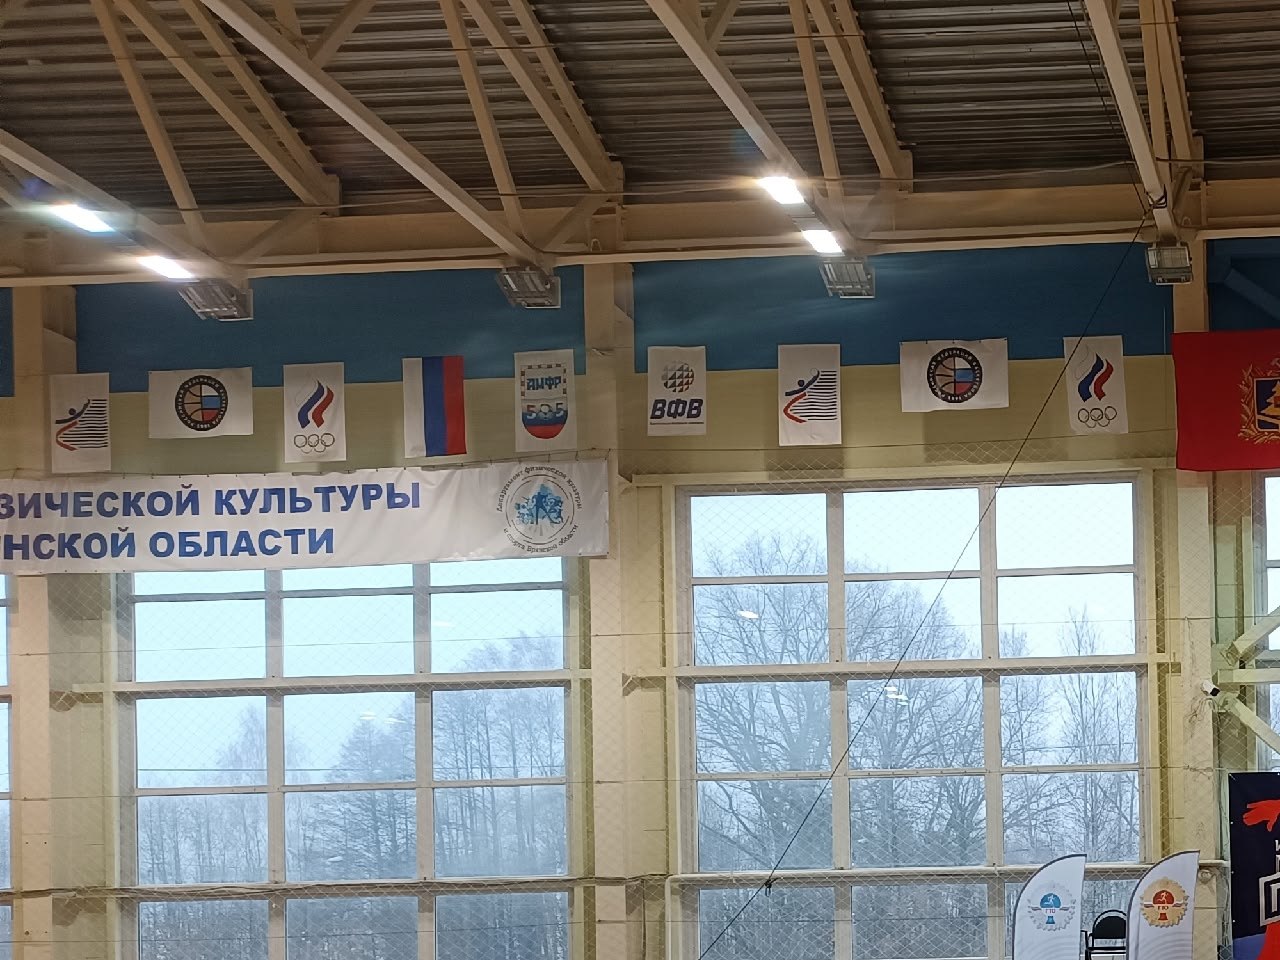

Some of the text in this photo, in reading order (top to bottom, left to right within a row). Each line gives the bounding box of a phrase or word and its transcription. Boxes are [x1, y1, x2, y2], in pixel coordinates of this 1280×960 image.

[650, 398, 704, 420] ВФВ
[214, 482, 420, 516] КУЛЬТУРЫ
[0, 527, 334, 560] НСКОЙ ОБЛАСТИ
